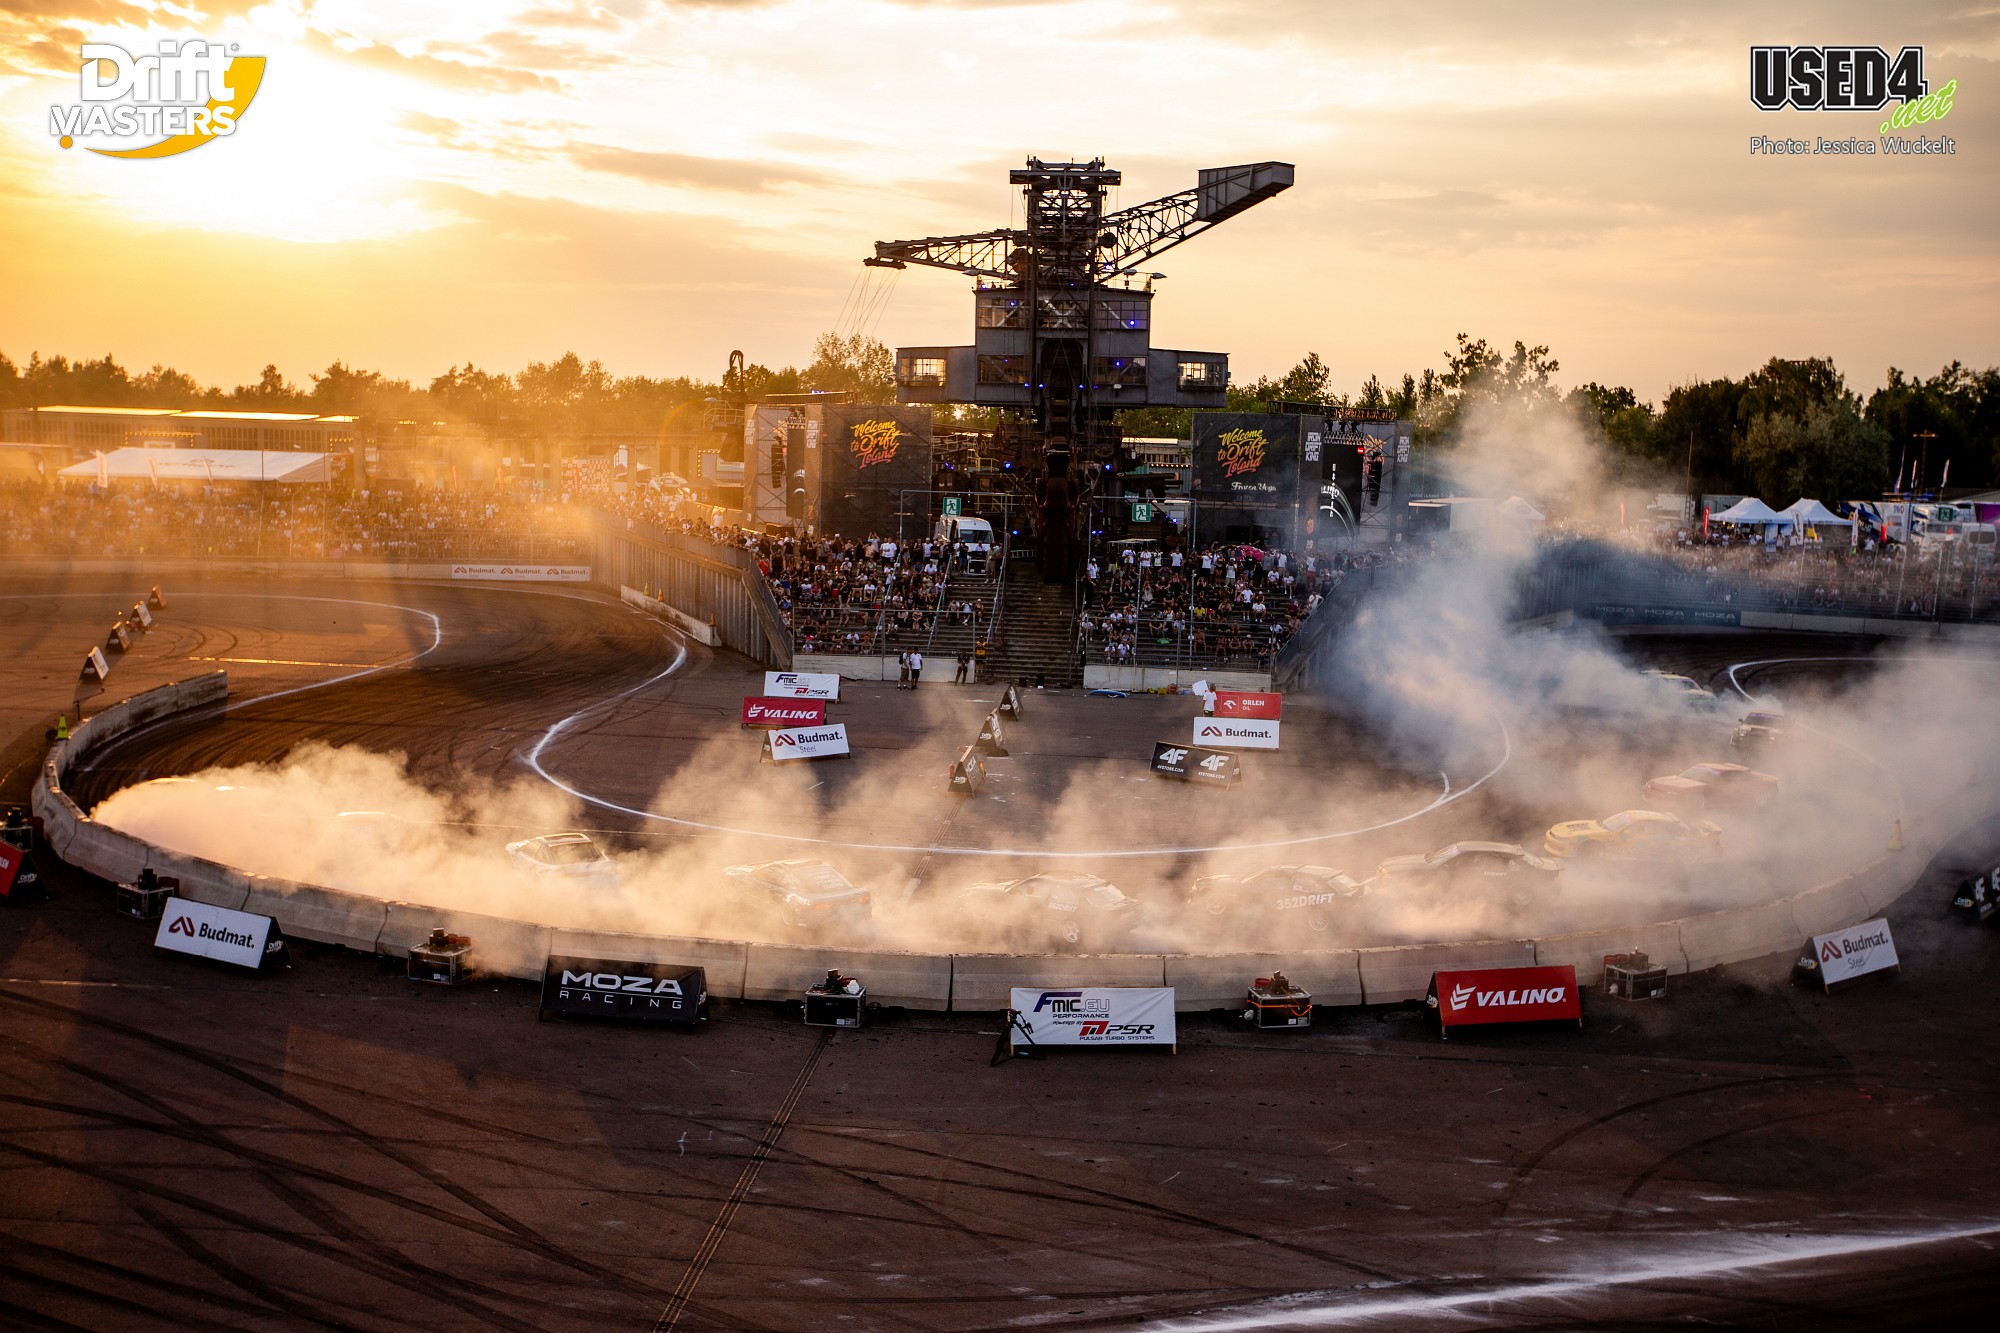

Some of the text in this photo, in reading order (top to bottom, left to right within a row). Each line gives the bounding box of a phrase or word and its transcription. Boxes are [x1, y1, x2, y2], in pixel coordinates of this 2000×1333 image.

[850, 420, 897, 437] Welcome
[1218, 428, 1263, 446] Welcome
[1242, 699, 1265, 707] ORLEN
[764, 709, 819, 719] VALINO
[798, 731, 843, 744] Budmat.
[1225, 728, 1272, 739] Budmat.
[1159, 748, 1188, 764] 4F
[1200, 755, 1229, 771] 4F
[1276, 893, 1334, 910] 352DRIFT
[198, 923, 255, 949] Budmat.
[1842, 931, 1889, 955] Budmat.
[561, 970, 683, 995] MOZA
[559, 990, 682, 1009] RACING
[1476, 987, 1566, 1007] VALINO
[1105, 1024, 1155, 1035] PSR
